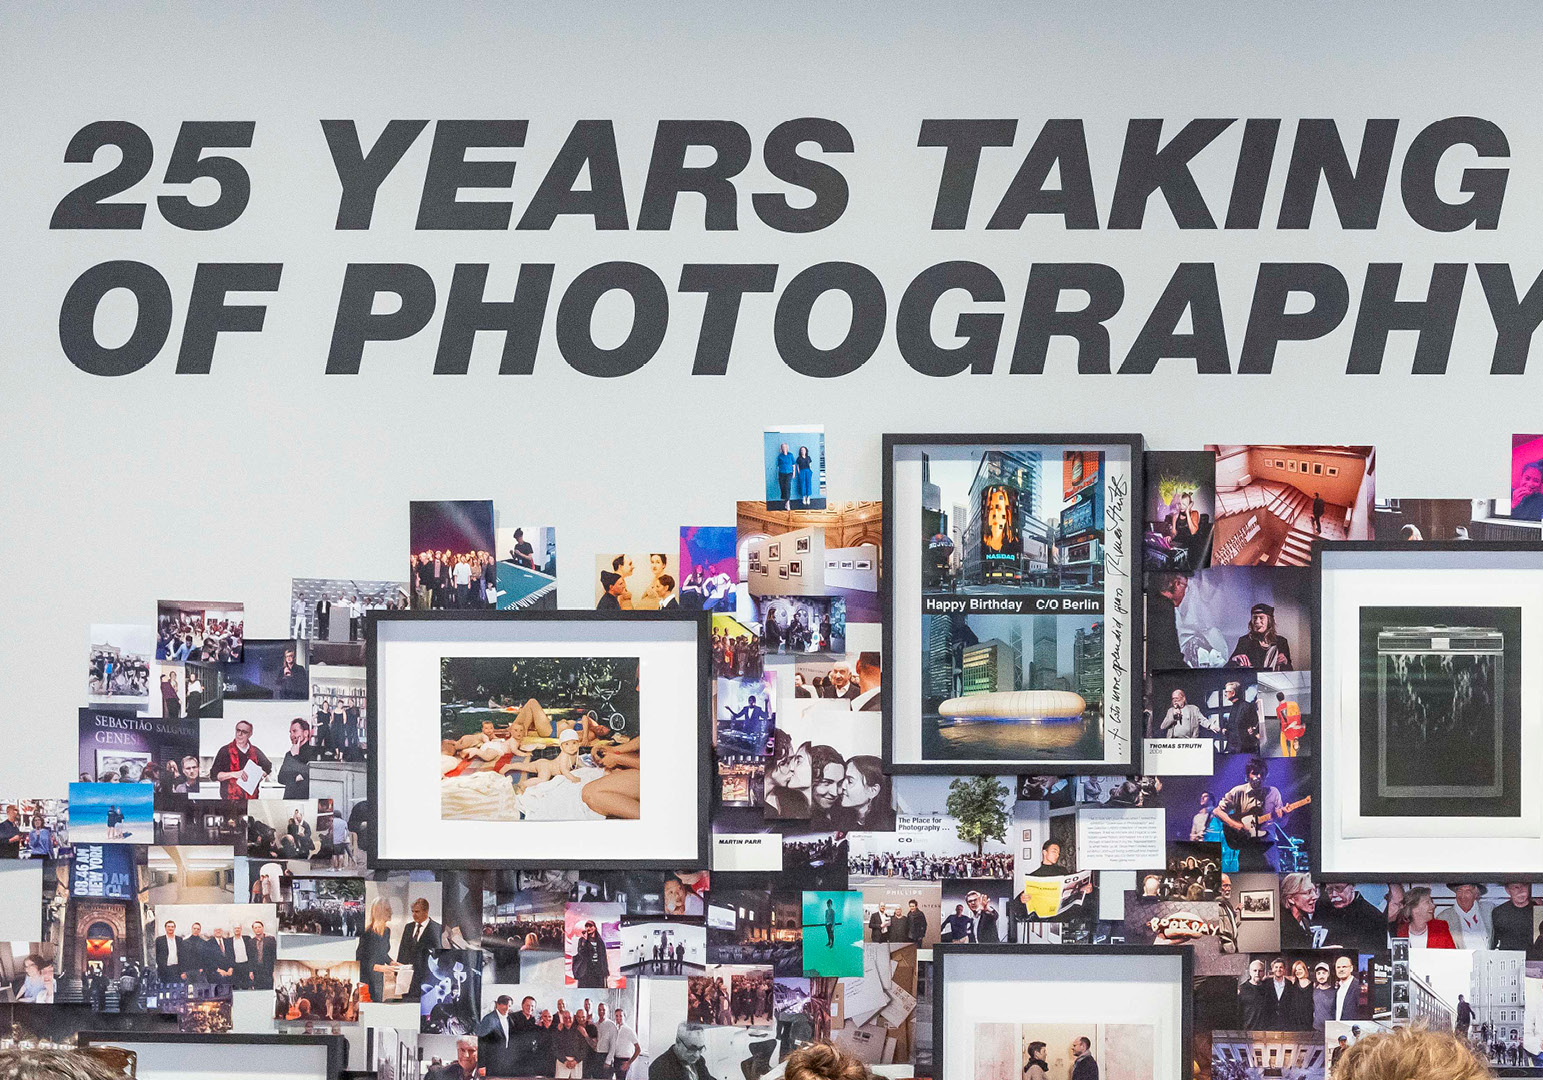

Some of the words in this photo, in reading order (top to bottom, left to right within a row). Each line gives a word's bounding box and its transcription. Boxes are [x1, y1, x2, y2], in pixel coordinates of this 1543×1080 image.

[49, 120, 256, 231] 25
[319, 116, 855, 233] YEARS
[916, 116, 1511, 232] TAKING
[58, 260, 283, 378] OF
[986, 553, 1015, 561] NASDAQ
[926, 599, 967, 612] Happy
[969, 598, 1023, 612] Birthday
[1036, 598, 1059, 610] C/O
[1062, 599, 1099, 610] Berlin
[95, 715, 153, 731] SEBASTIÃO
[89, 845, 103, 871] YORK
[88, 871, 103, 896] NEW
